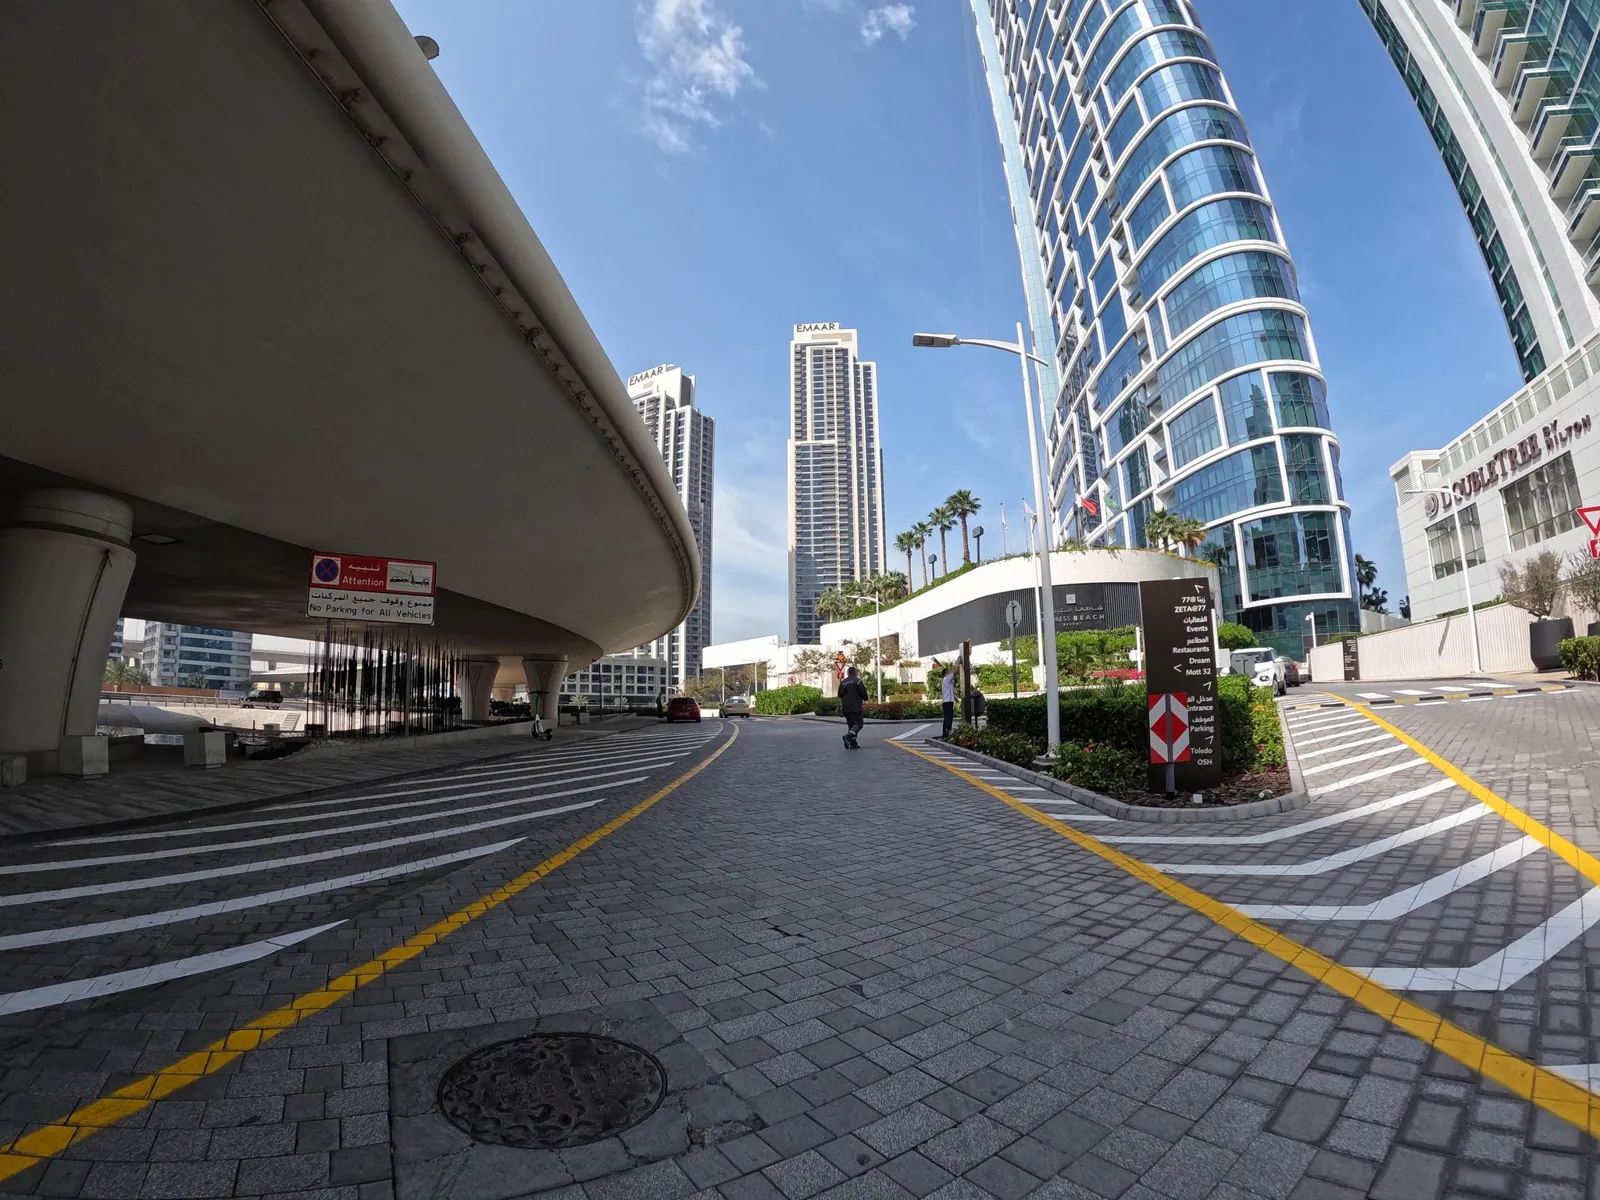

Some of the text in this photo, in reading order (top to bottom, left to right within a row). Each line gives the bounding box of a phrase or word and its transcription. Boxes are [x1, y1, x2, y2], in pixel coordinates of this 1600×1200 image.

[796, 322, 836, 333] EMAAR
[629, 366, 664, 386] EMAAR
[1542, 419, 1557, 437] BY
[1544, 414, 1592, 452] HILTON
[348, 564, 380, 572] تنبيه
[342, 576, 384, 586] Attention
[311, 592, 432, 609] ممنوع وقوف جميع المركبات
[1174, 605, 1206, 613] ZETA@77
[309, 603, 432, 620] No Parking for All Vehicles
